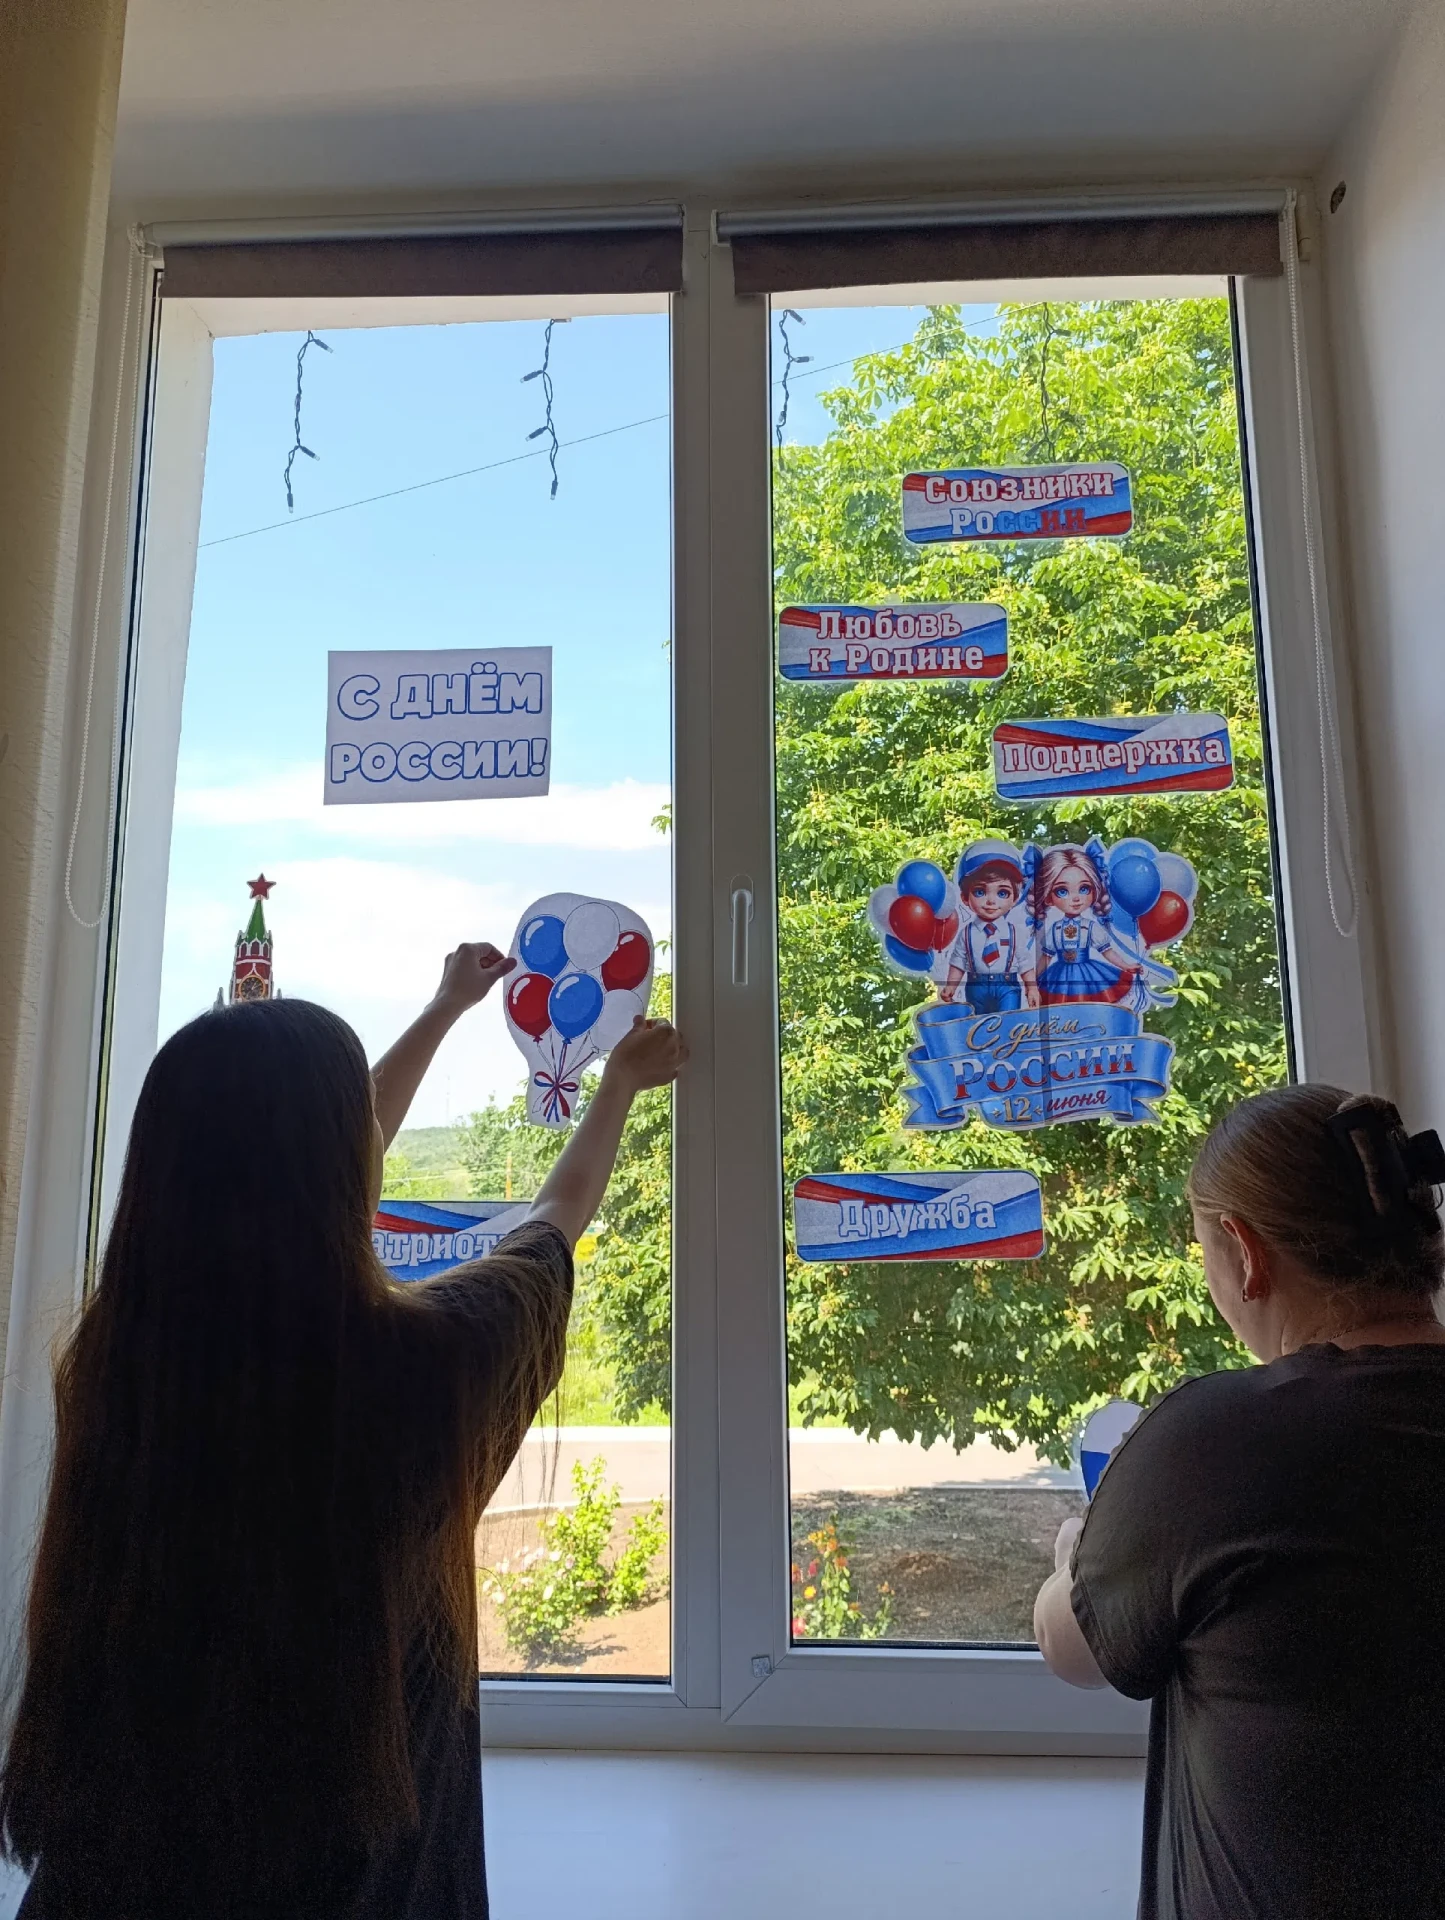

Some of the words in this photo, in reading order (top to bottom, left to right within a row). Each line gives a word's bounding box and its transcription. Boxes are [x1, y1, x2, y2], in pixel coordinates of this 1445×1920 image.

[925, 473, 1114, 504] Союзники
[950, 508, 1087, 535] России
[816, 608, 962, 639] Любовь
[809, 648, 830, 672] к
[845, 644, 984, 674] Родине
[337, 675, 380, 721] С
[390, 661, 542, 719] ДНЁМ
[330, 737, 547, 783] РОССИИ!
[1002, 738, 1226, 774] Поддержка
[950, 1043, 1137, 1100] РОССИИ
[1002, 1096, 1032, 1122] 12
[1046, 1089, 1111, 1111] июня
[838, 1194, 996, 1238] Дружба
